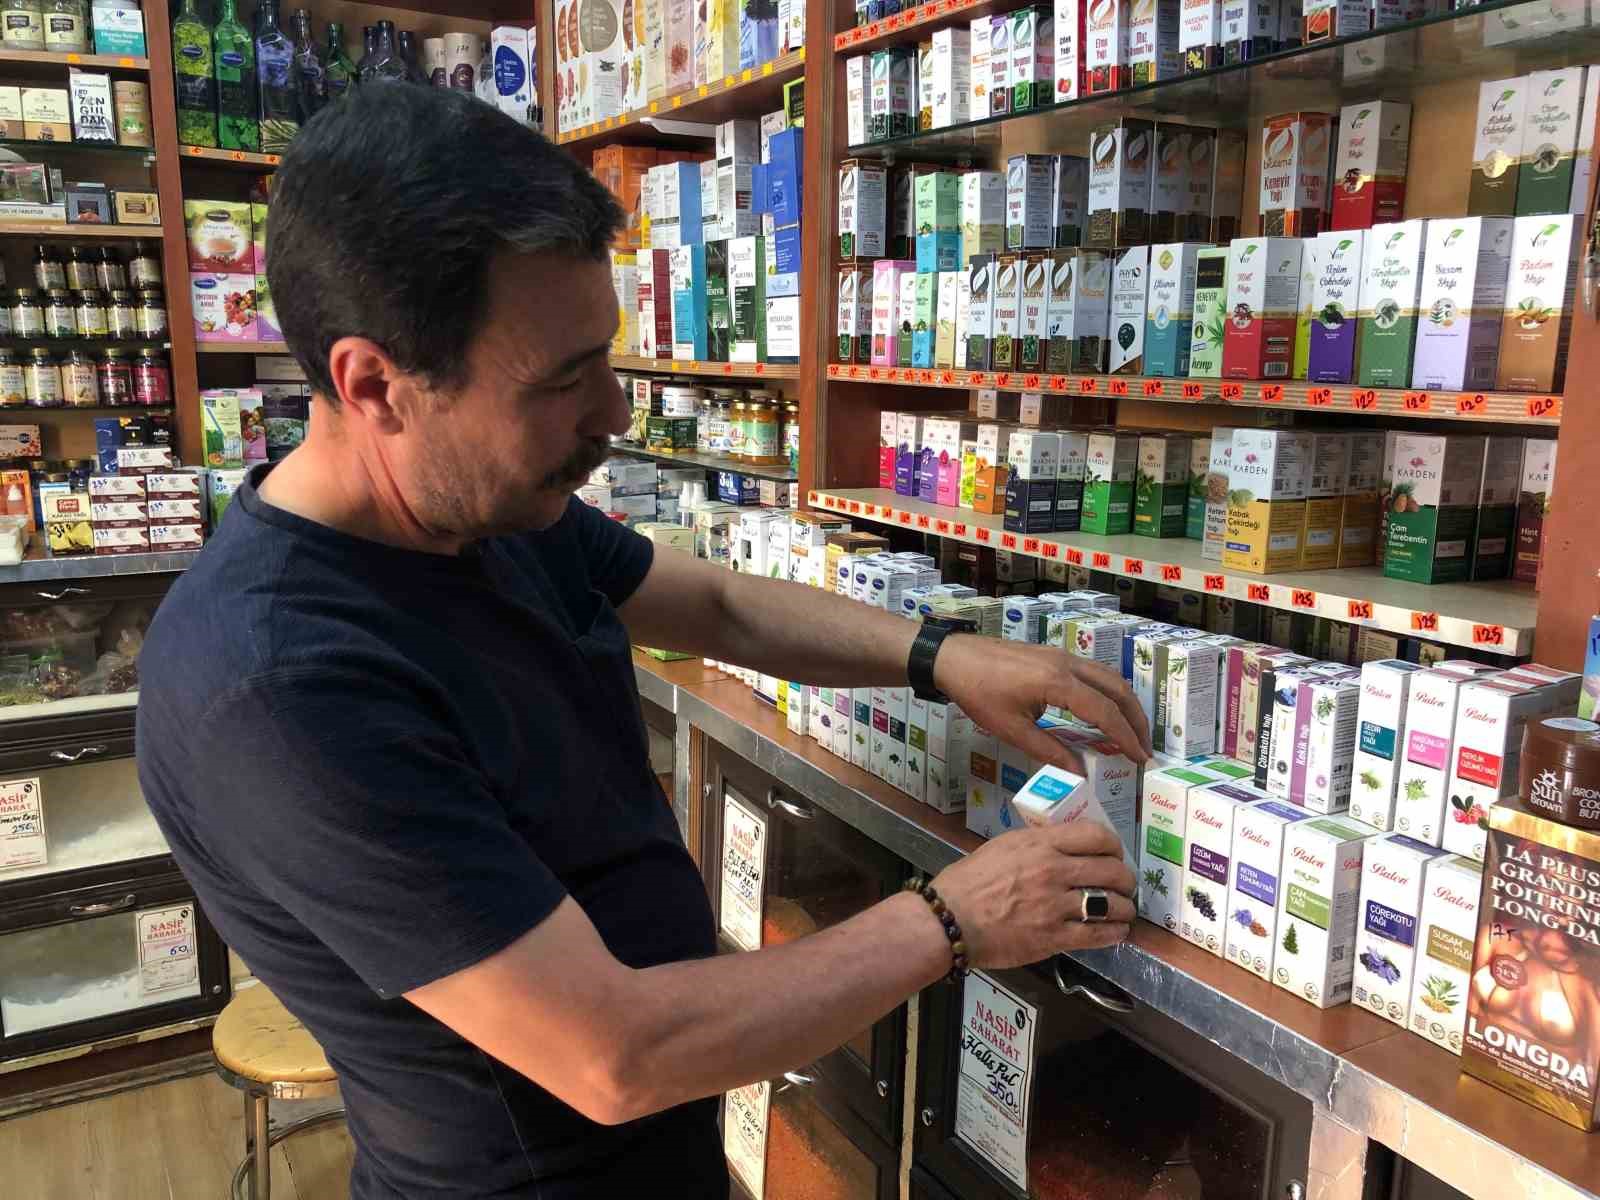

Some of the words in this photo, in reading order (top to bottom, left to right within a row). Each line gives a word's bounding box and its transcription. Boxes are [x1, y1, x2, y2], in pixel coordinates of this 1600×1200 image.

[1405, 393, 1428, 409] 120
[1460, 393, 1485, 412] 120
[1529, 397, 1555, 416] 120
[1233, 464, 1268, 477] KARDEN
[1397, 468, 1437, 480] KARDEN
[1389, 532, 1428, 545] Terebentin
[1163, 566, 1182, 580] 125
[1206, 576, 1225, 590] 125
[1251, 585, 1270, 600] 125
[1294, 593, 1313, 607] 125
[1350, 603, 1369, 618] 125
[1417, 613, 1436, 629] 125
[1474, 626, 1501, 643] 125
[1415, 691, 1447, 708] Balen
[1464, 706, 1499, 726] Balen
[1150, 792, 1178, 811] Balen
[1193, 808, 1224, 830] Balen
[1240, 826, 1271, 848] Balen
[1291, 846, 1326, 869] Balen
[1505, 844, 1534, 866] LA
[1541, 855, 1600, 887] PLUS
[1369, 862, 1410, 886] Balen
[1500, 861, 1600, 908] GRANDE
[1432, 885, 1476, 911] Balen
[1368, 913, 1388, 928] YAĞI
[1369, 904, 1413, 927] ÇÖREKOTU
[1492, 894, 1560, 930] LONG
[147, 928, 187, 940] BAHARAT
[150, 919, 185, 933] NASİP
[975, 1000, 1018, 1041] NASİP
[970, 1017, 1021, 1063] BAHARAT
[1468, 1016, 1589, 1089] LONGDA
